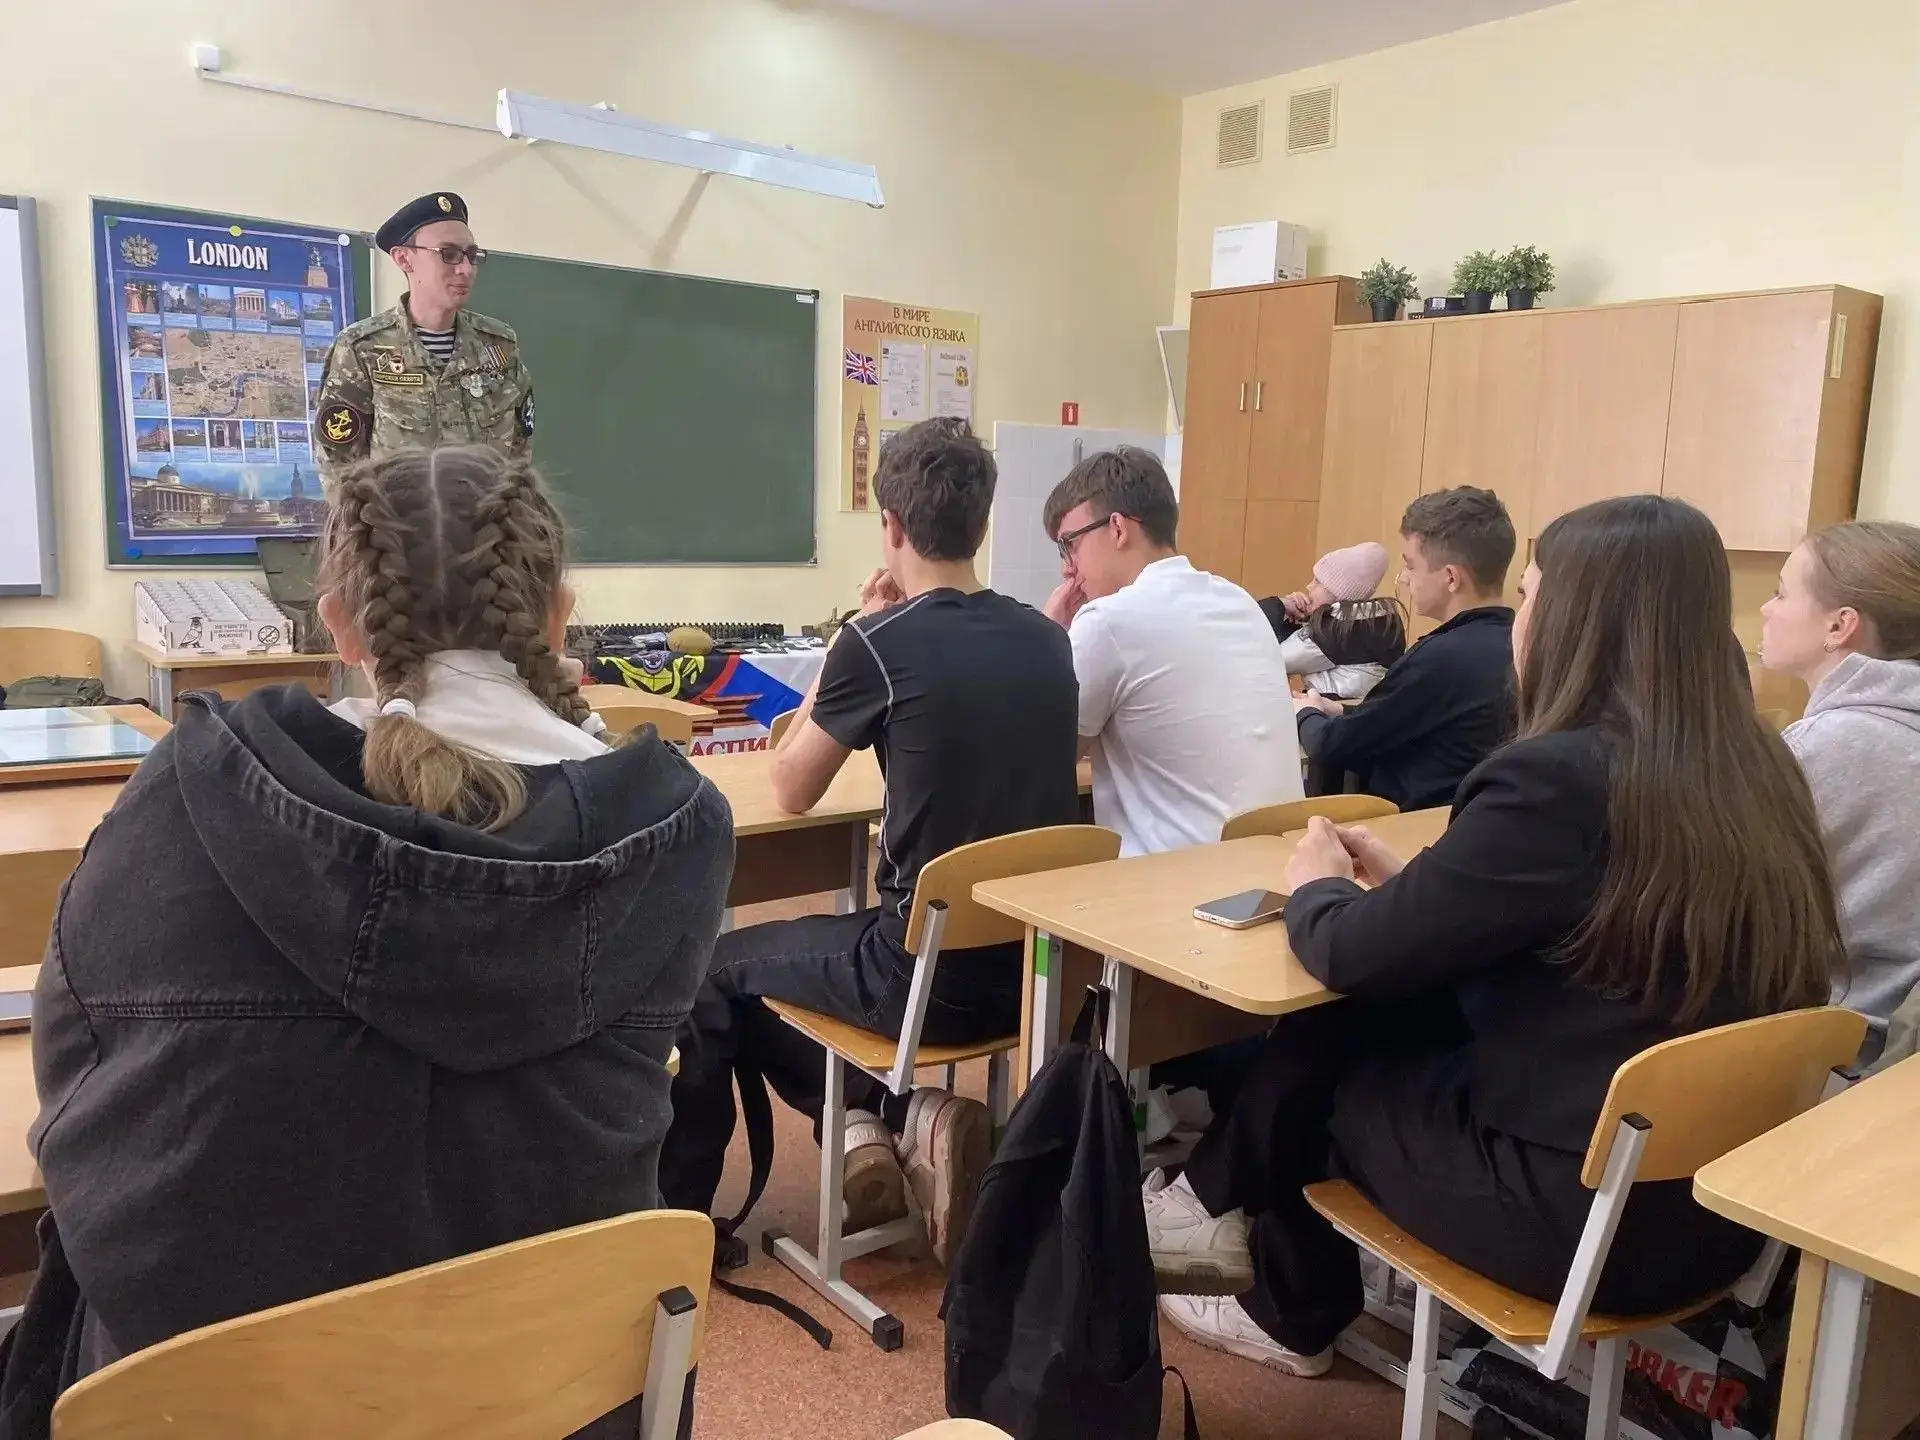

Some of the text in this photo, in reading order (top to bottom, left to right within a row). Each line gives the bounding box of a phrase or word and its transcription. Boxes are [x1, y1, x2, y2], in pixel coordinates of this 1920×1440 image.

[187, 238, 269, 271] LONDON
[893, 306, 931, 323] В МИРЕ
[854, 319, 966, 343] АНГЛИЙСКОГО ЯЗЫКА
[1588, 1337, 1748, 1431] ORKER
